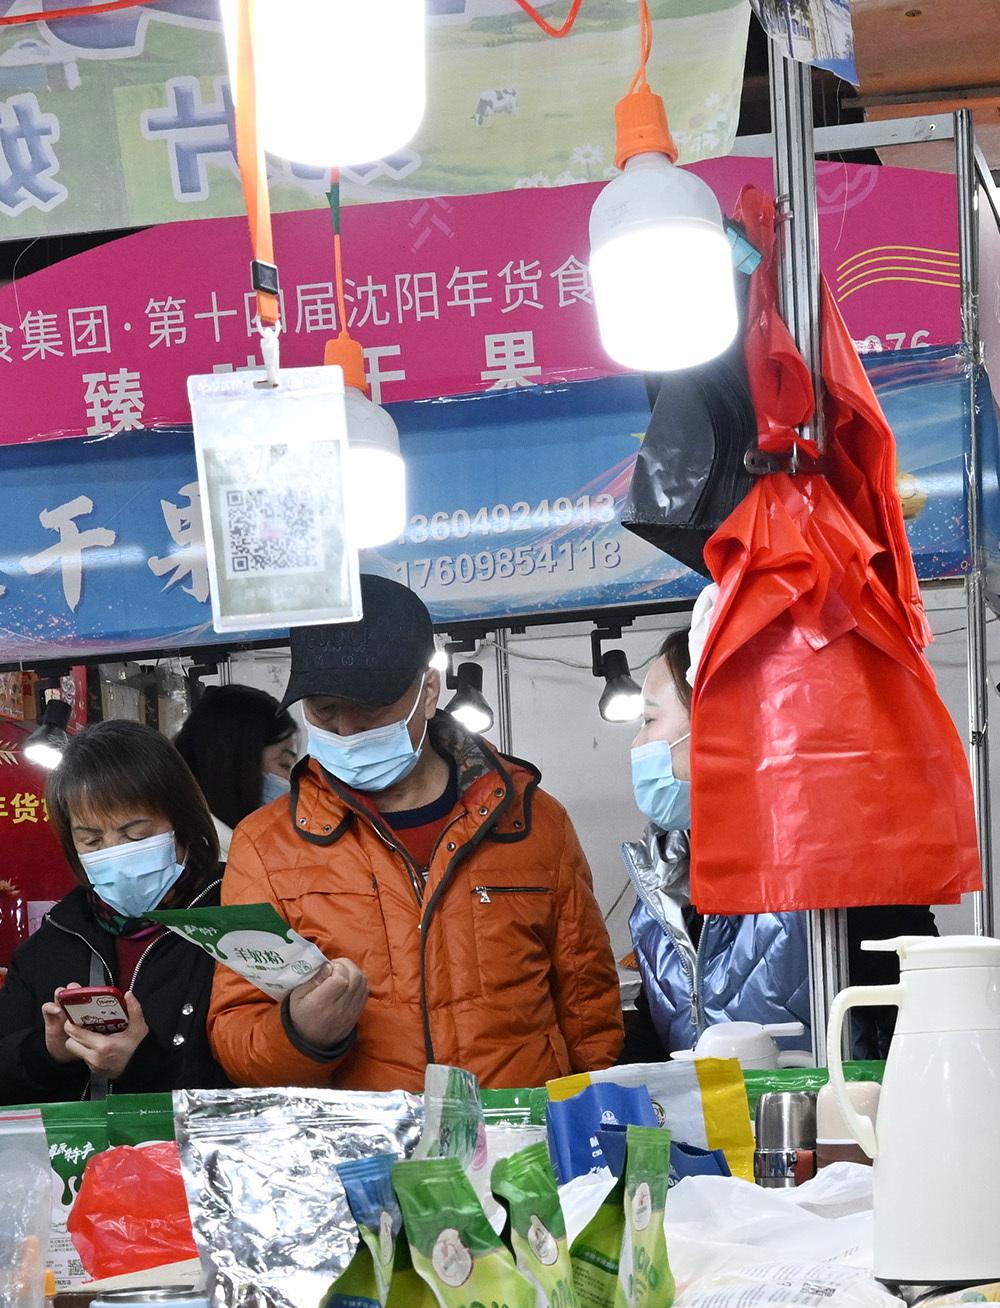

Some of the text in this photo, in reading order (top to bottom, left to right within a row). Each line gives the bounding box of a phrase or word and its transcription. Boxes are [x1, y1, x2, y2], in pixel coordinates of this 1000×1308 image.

[395, 540, 622, 592] 17609854118
[233, 946, 285, 965] 羊奶粉
